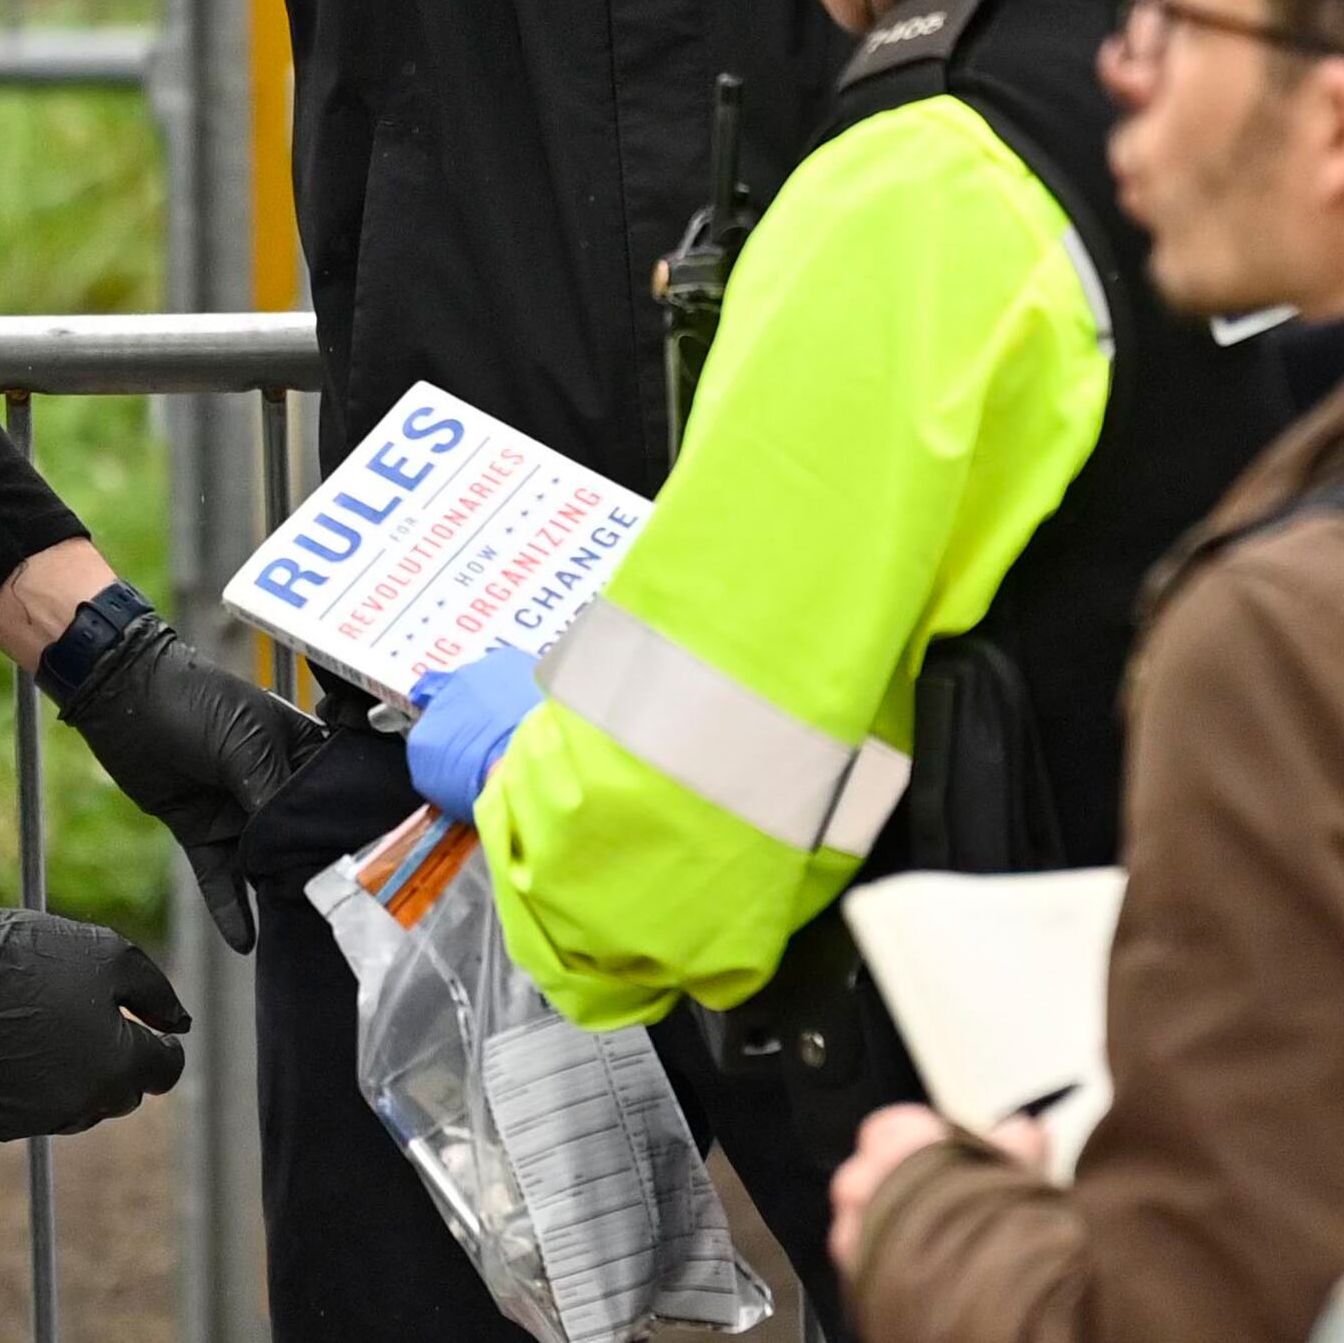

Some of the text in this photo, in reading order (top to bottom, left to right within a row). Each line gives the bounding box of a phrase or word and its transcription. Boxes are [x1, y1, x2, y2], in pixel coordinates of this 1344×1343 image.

[254, 407, 465, 609] RULES
[338, 448, 525, 640] REVOLUTIONARIES
[389, 516, 417, 543] FOR
[454, 545, 498, 587] HOW
[455, 487, 603, 634] ORGANIZING
[514, 506, 638, 630] CHANGE
